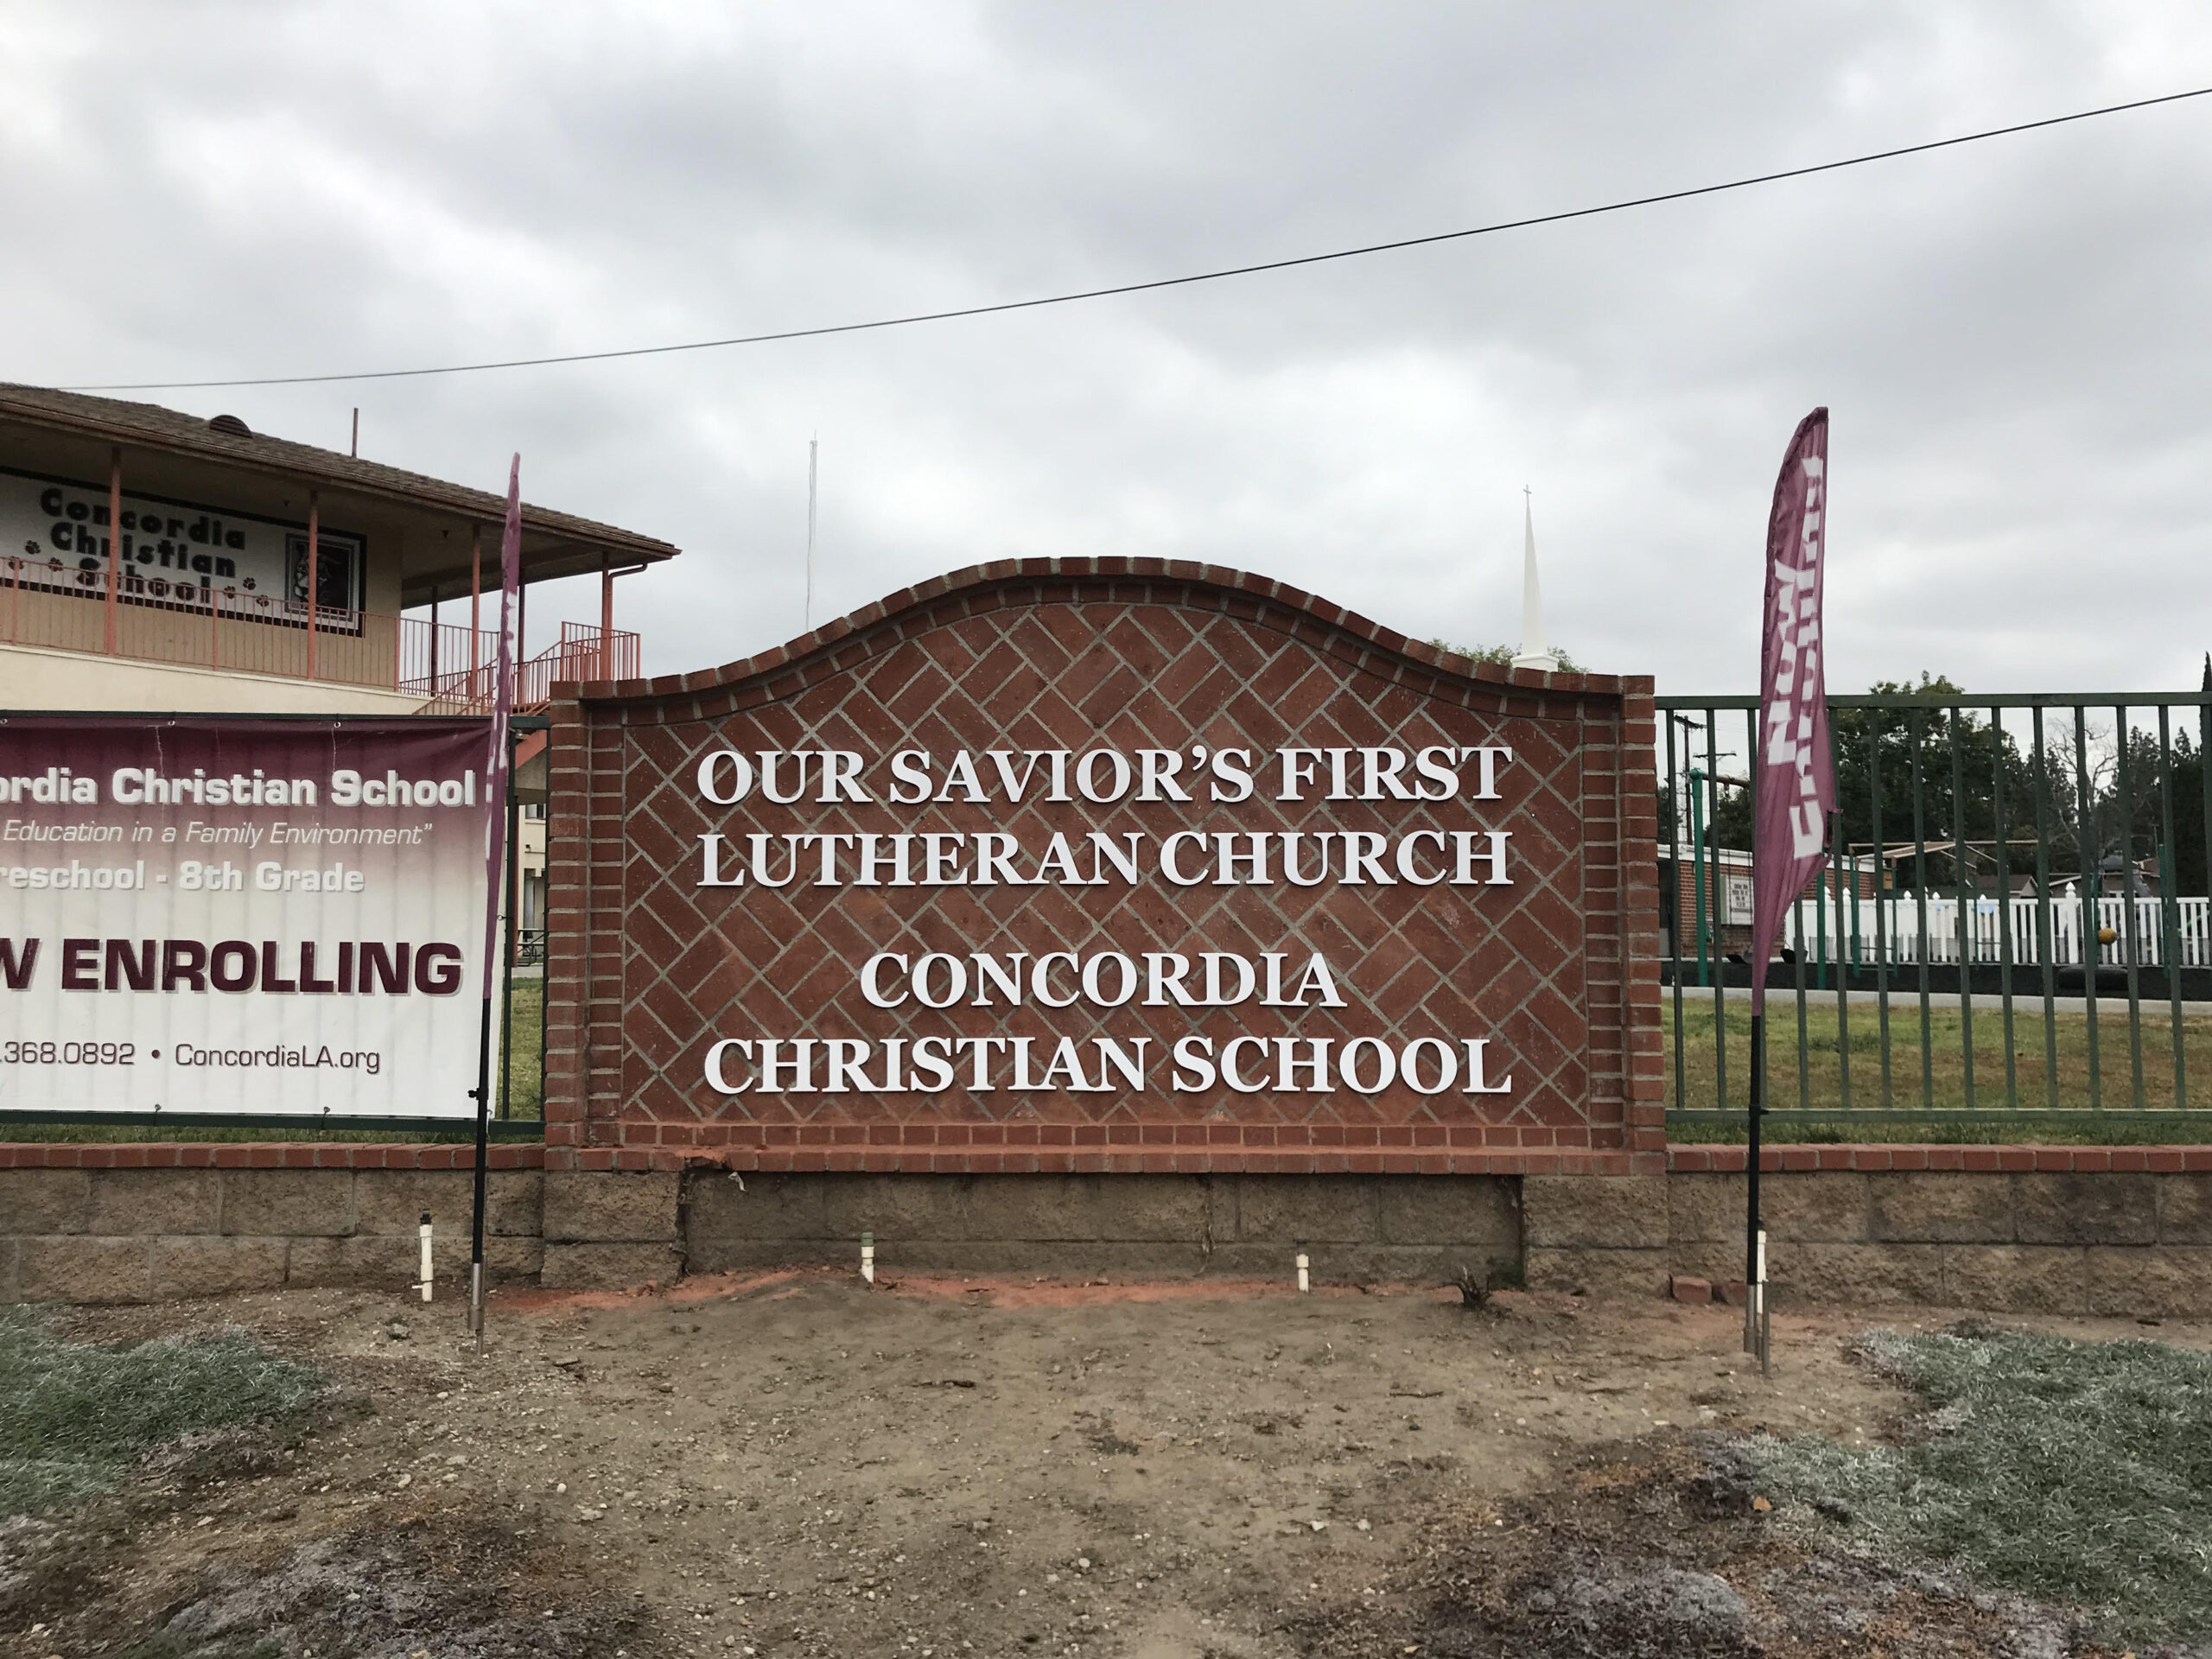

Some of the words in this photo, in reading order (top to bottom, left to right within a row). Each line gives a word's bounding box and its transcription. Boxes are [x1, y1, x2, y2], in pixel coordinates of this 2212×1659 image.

[40, 487, 246, 550] Concordia
[112, 768, 317, 806] Christian
[331, 769, 476, 808] School
[697, 750, 872, 803] OUR
[1274, 746, 1513, 801] FIRST
[3, 820, 123, 842] Education
[131, 821, 153, 842] in
[162, 827, 177, 842] a
[185, 822, 264, 849] Family
[696, 833, 1145, 887] LUTHERAN
[1160, 830, 1514, 886] CHURCH
[179, 861, 243, 891] 8th
[256, 862, 365, 893] Grade
[62, 938, 464, 997] ENROLLING
[861, 951, 1346, 1009] CONCORDIA
[175, 1044, 380, 1074] ConcordiaLA.org
[704, 1038, 1152, 1094] CHRISTIAN
[1173, 1037, 1512, 1094] SCHOOL
